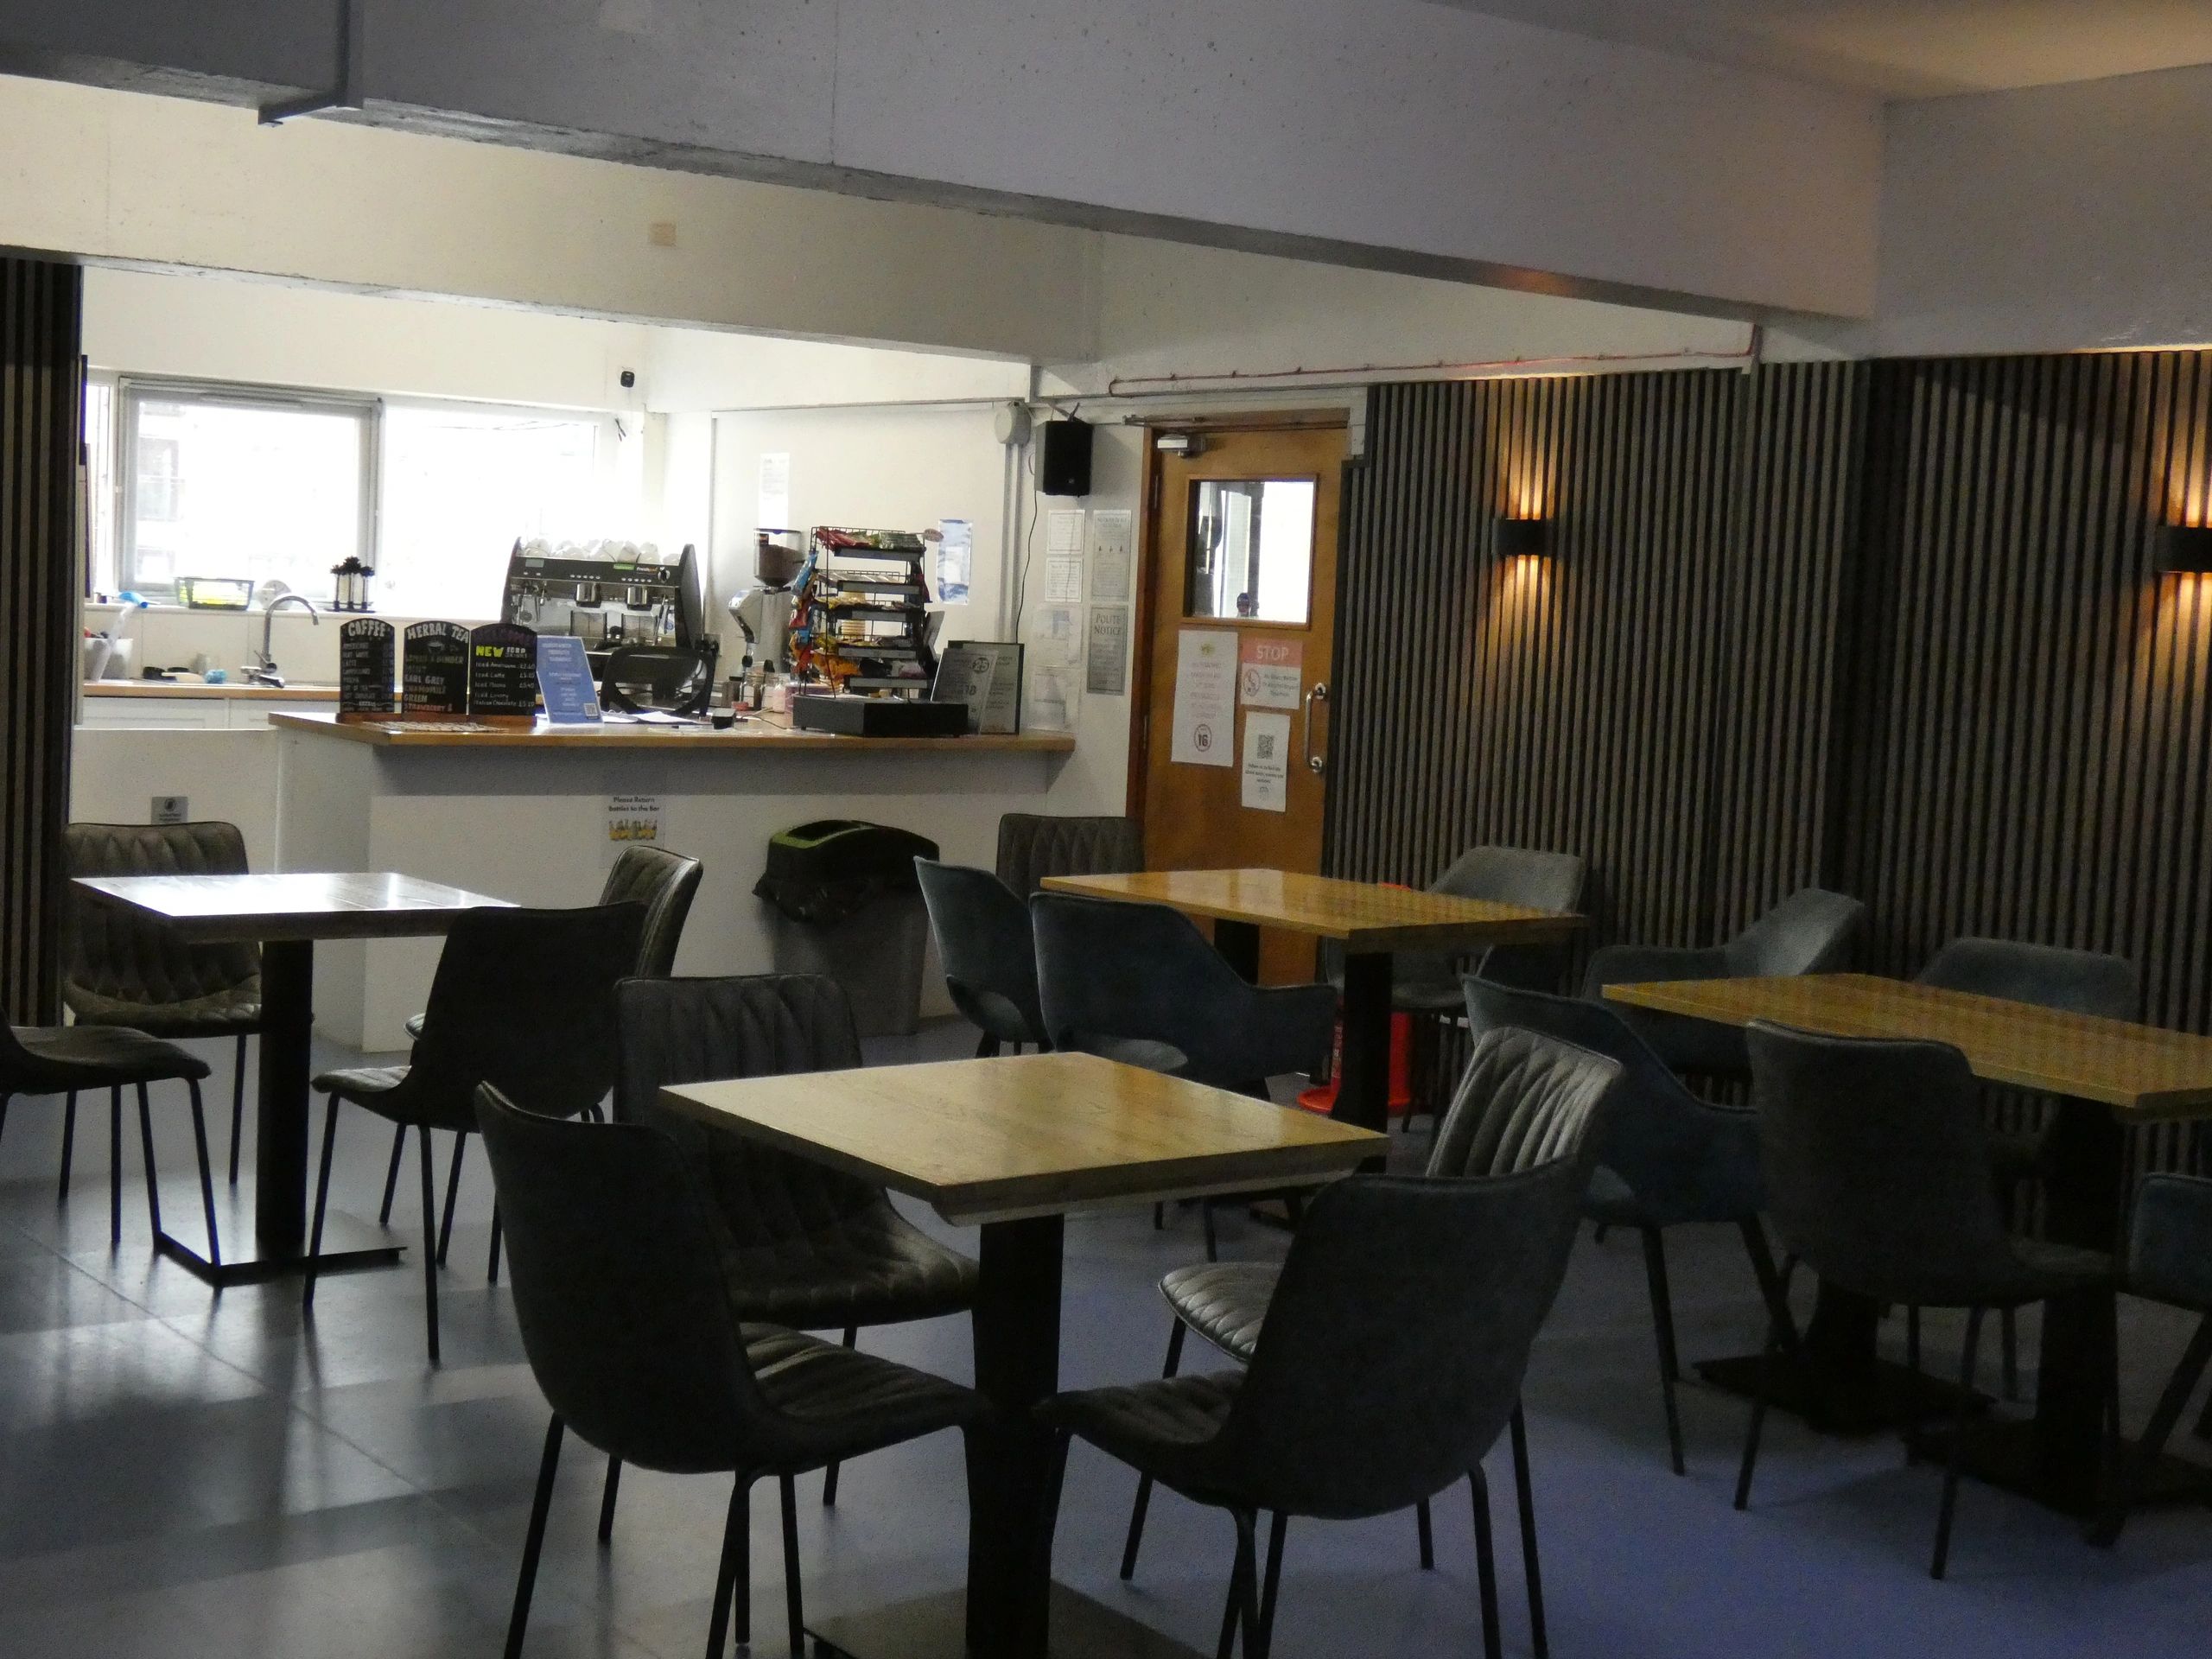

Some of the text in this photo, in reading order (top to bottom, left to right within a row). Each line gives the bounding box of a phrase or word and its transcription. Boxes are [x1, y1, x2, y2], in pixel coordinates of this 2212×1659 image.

[1096, 613, 1121, 624] POLITE
[348, 620, 385, 638] COFFEE
[407, 622, 447, 640] HERBAL
[451, 625, 469, 644] TEA
[1094, 623, 1122, 636] NOTICE
[475, 645, 505, 658] NEW
[1256, 646, 1290, 660] STOP
[1198, 734, 1209, 747] 16
